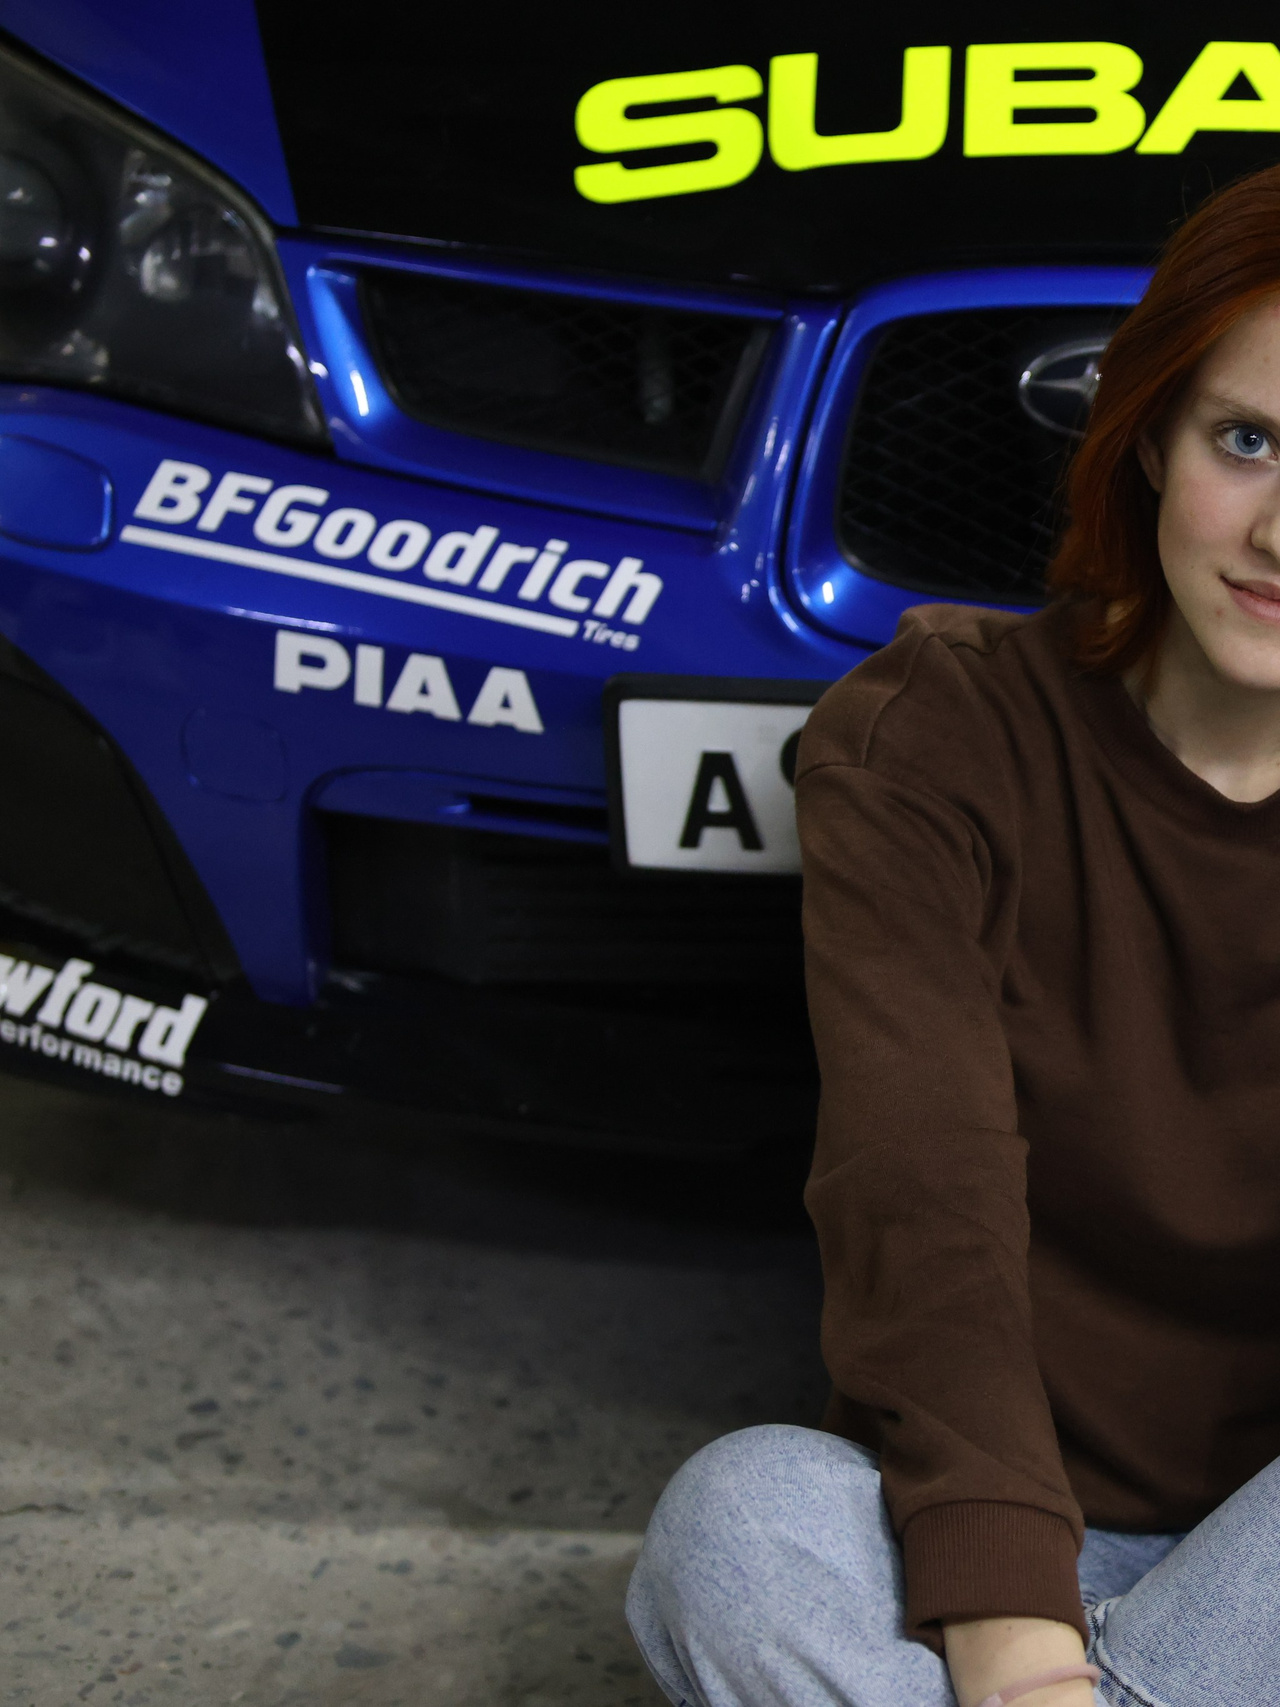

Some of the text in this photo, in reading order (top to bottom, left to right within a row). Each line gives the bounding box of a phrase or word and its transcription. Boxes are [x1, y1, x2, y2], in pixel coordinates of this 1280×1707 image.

[133, 458, 663, 625] BFGoodrich
[273, 628, 544, 734] PIAA
[582, 618, 641, 652] Tires
